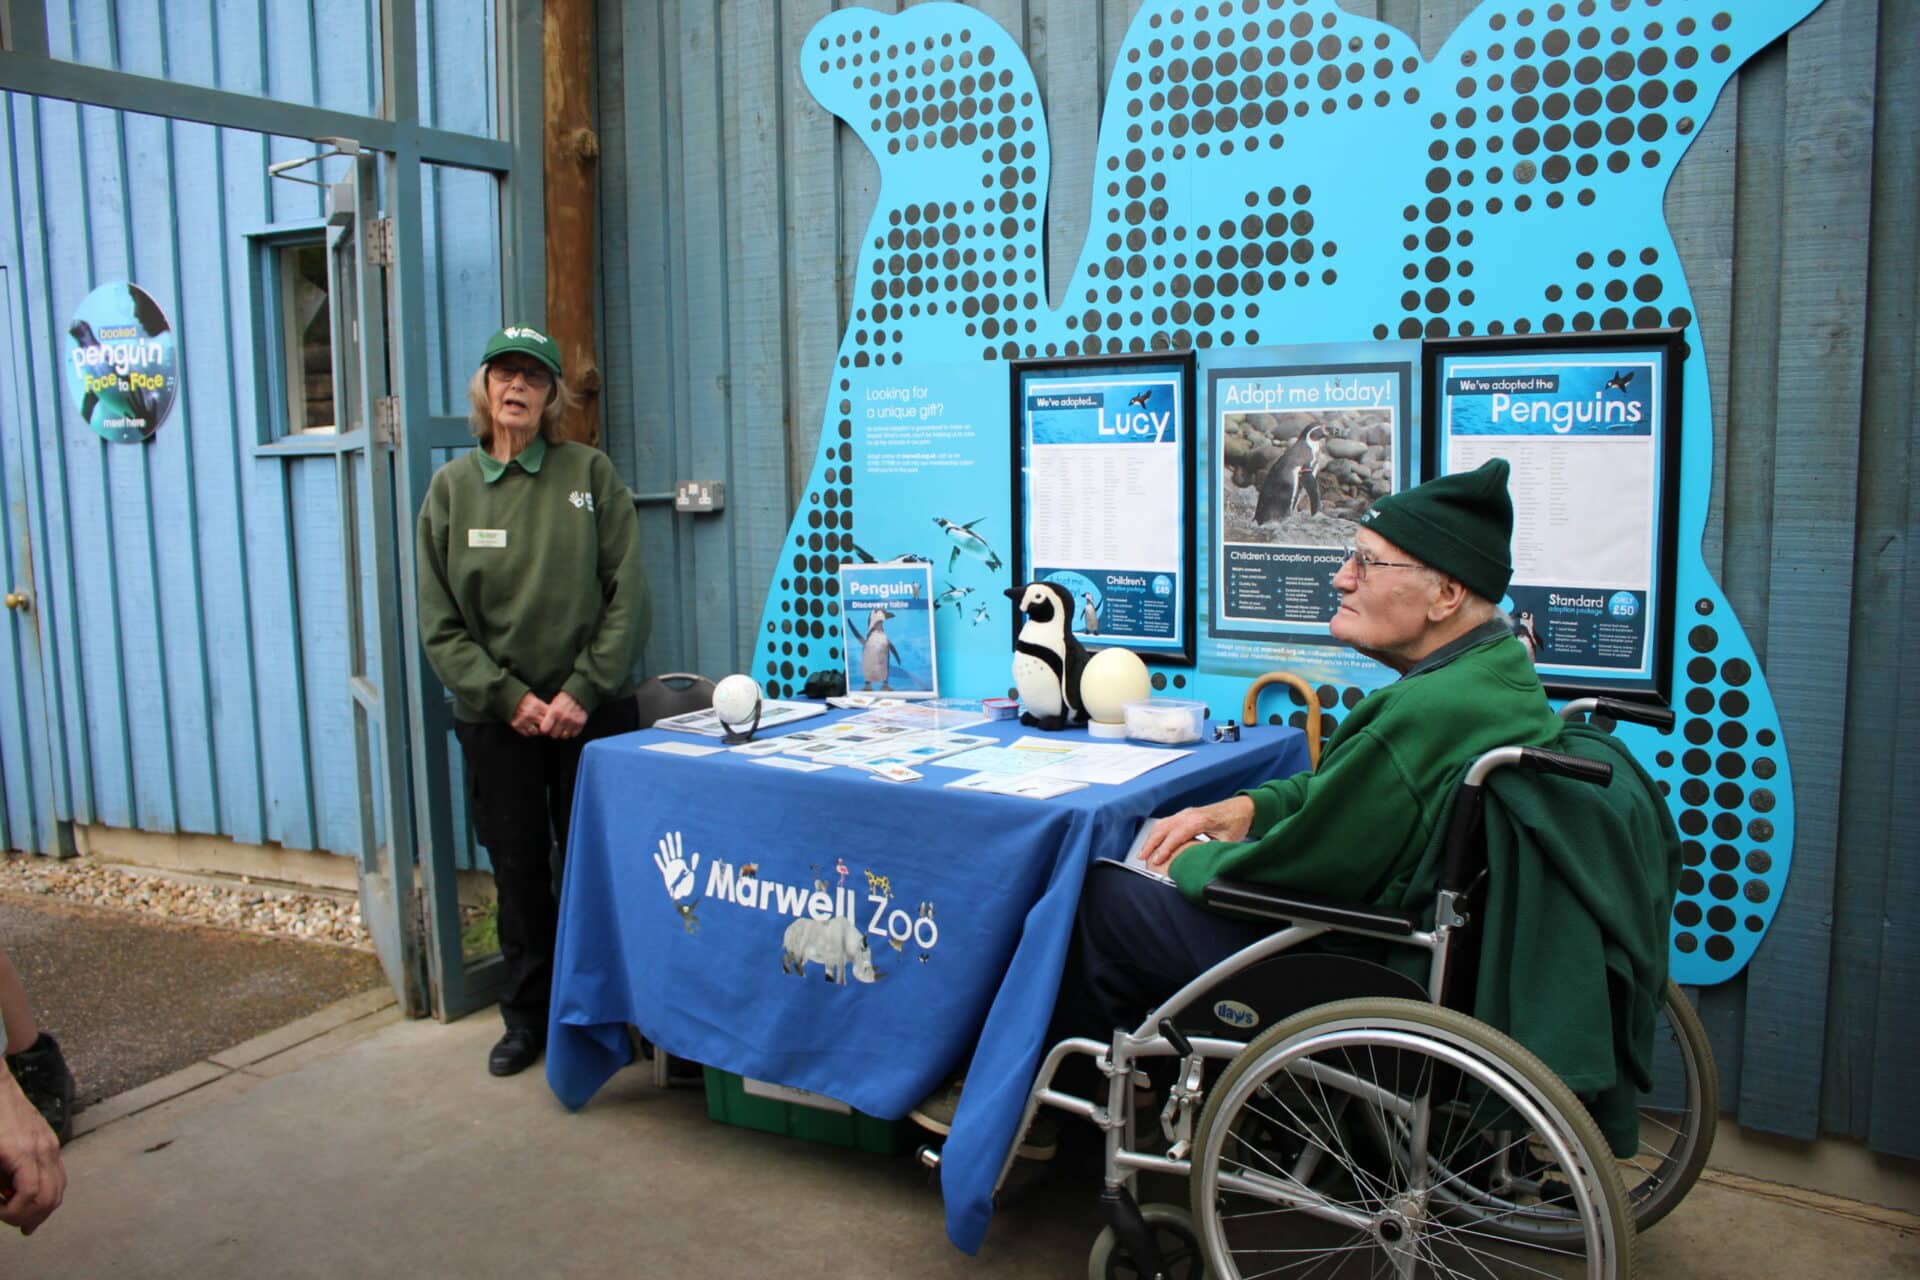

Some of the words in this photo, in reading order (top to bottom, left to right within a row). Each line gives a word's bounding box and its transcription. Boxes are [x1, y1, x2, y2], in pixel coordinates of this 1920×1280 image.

[73, 337, 162, 380] penguin
[85, 373, 118, 393] Face
[118, 378, 129, 391] to
[130, 372, 164, 391] Face
[1460, 379, 1490, 391] We've
[1492, 377, 1534, 394] adopted
[1536, 377, 1555, 390] the
[866, 386, 911, 402] Looking
[912, 385, 929, 399] for
[1224, 381, 1284, 411] Adopt
[1288, 386, 1321, 402] me
[1324, 378, 1392, 408] today!
[1036, 397, 1060, 408] We've
[867, 407, 877, 418] a
[878, 406, 917, 421] unique
[920, 402, 945, 421] gift?
[1491, 391, 1643, 434] Penguins
[1098, 407, 1171, 444] Lucy
[1231, 551, 1271, 562] Children's
[1272, 553, 1312, 565] adoption
[1313, 555, 1346, 567] packag
[1106, 575, 1147, 587] Children's
[850, 581, 914, 599] Penguin
[852, 601, 889, 609] Discovery
[1549, 593, 1605, 608] Standard
[1613, 604, 1635, 616] £50
[705, 859, 857, 927] Marwell
[867, 894, 939, 949] Zoo
